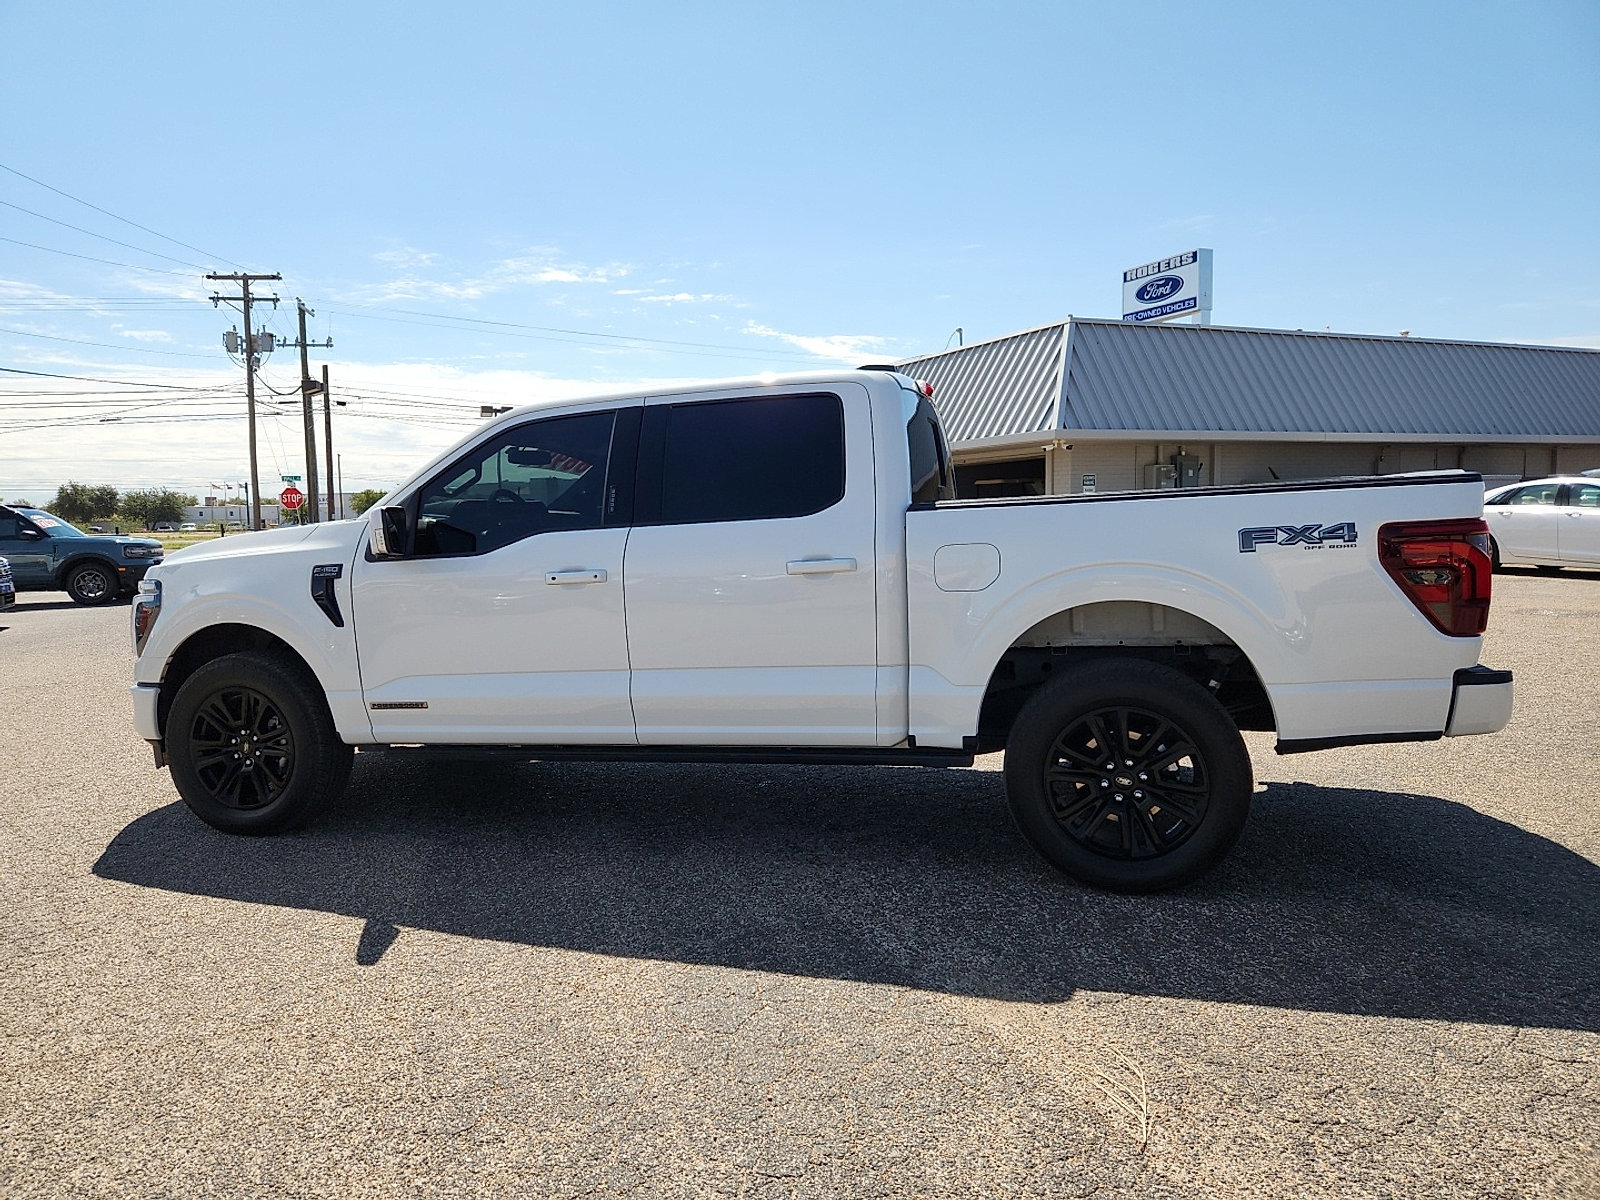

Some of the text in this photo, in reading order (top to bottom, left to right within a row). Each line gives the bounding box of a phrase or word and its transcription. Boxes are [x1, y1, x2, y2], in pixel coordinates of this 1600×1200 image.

[1126, 253, 1194, 281] ROGERS
[1144, 278, 1172, 299] Ford
[1124, 300, 1195, 322] PRE-OWNED VEHICLES
[282, 493, 302, 503] STOP
[1238, 522, 1358, 553] FX4
